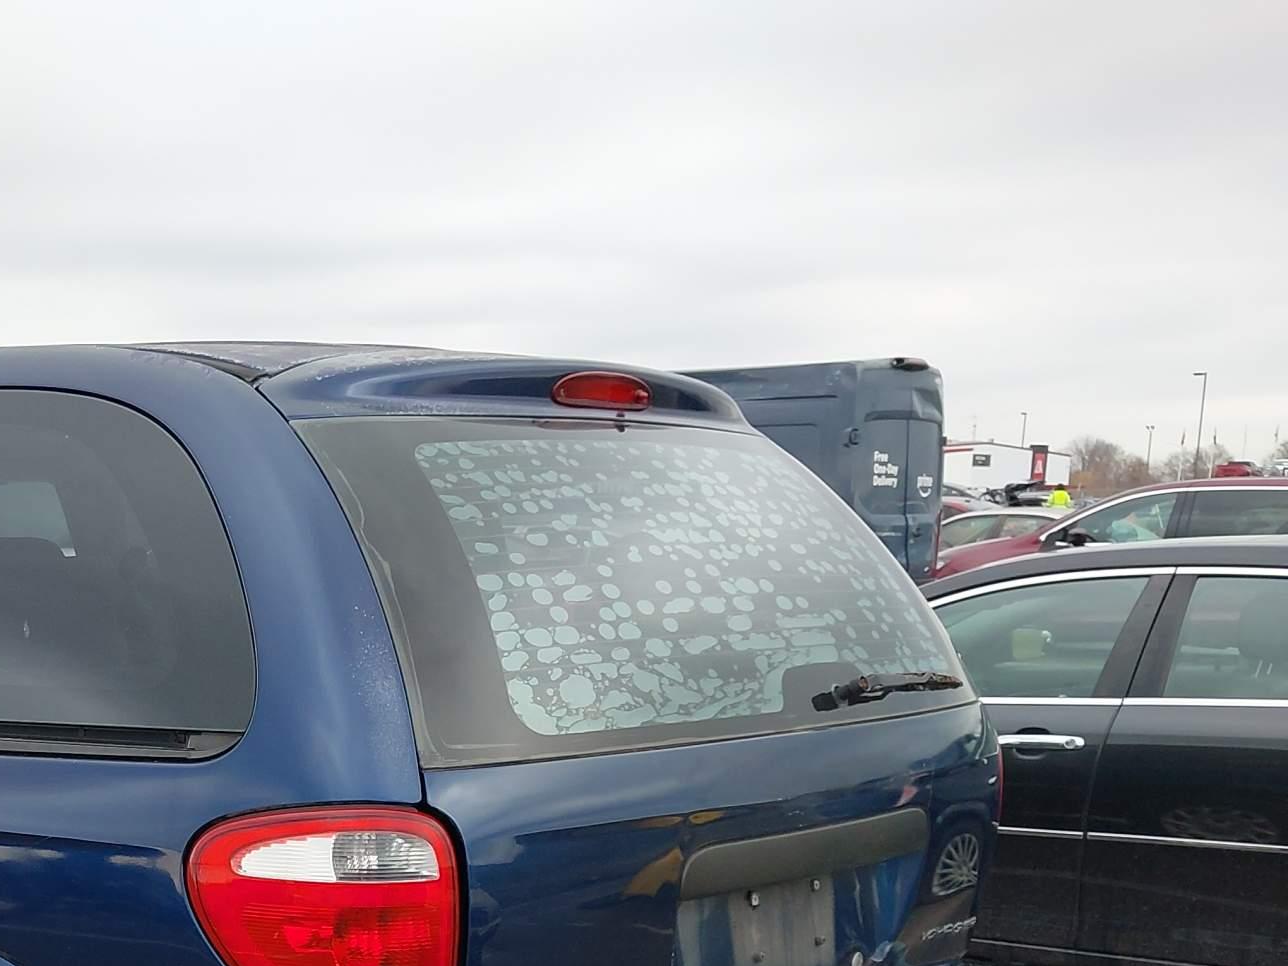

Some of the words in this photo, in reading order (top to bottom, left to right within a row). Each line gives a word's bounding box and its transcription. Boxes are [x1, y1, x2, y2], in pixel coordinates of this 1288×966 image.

[874, 450, 889, 462] Free
[873, 463, 899, 476] One-Day
[872, 475, 898, 488] Delivery
